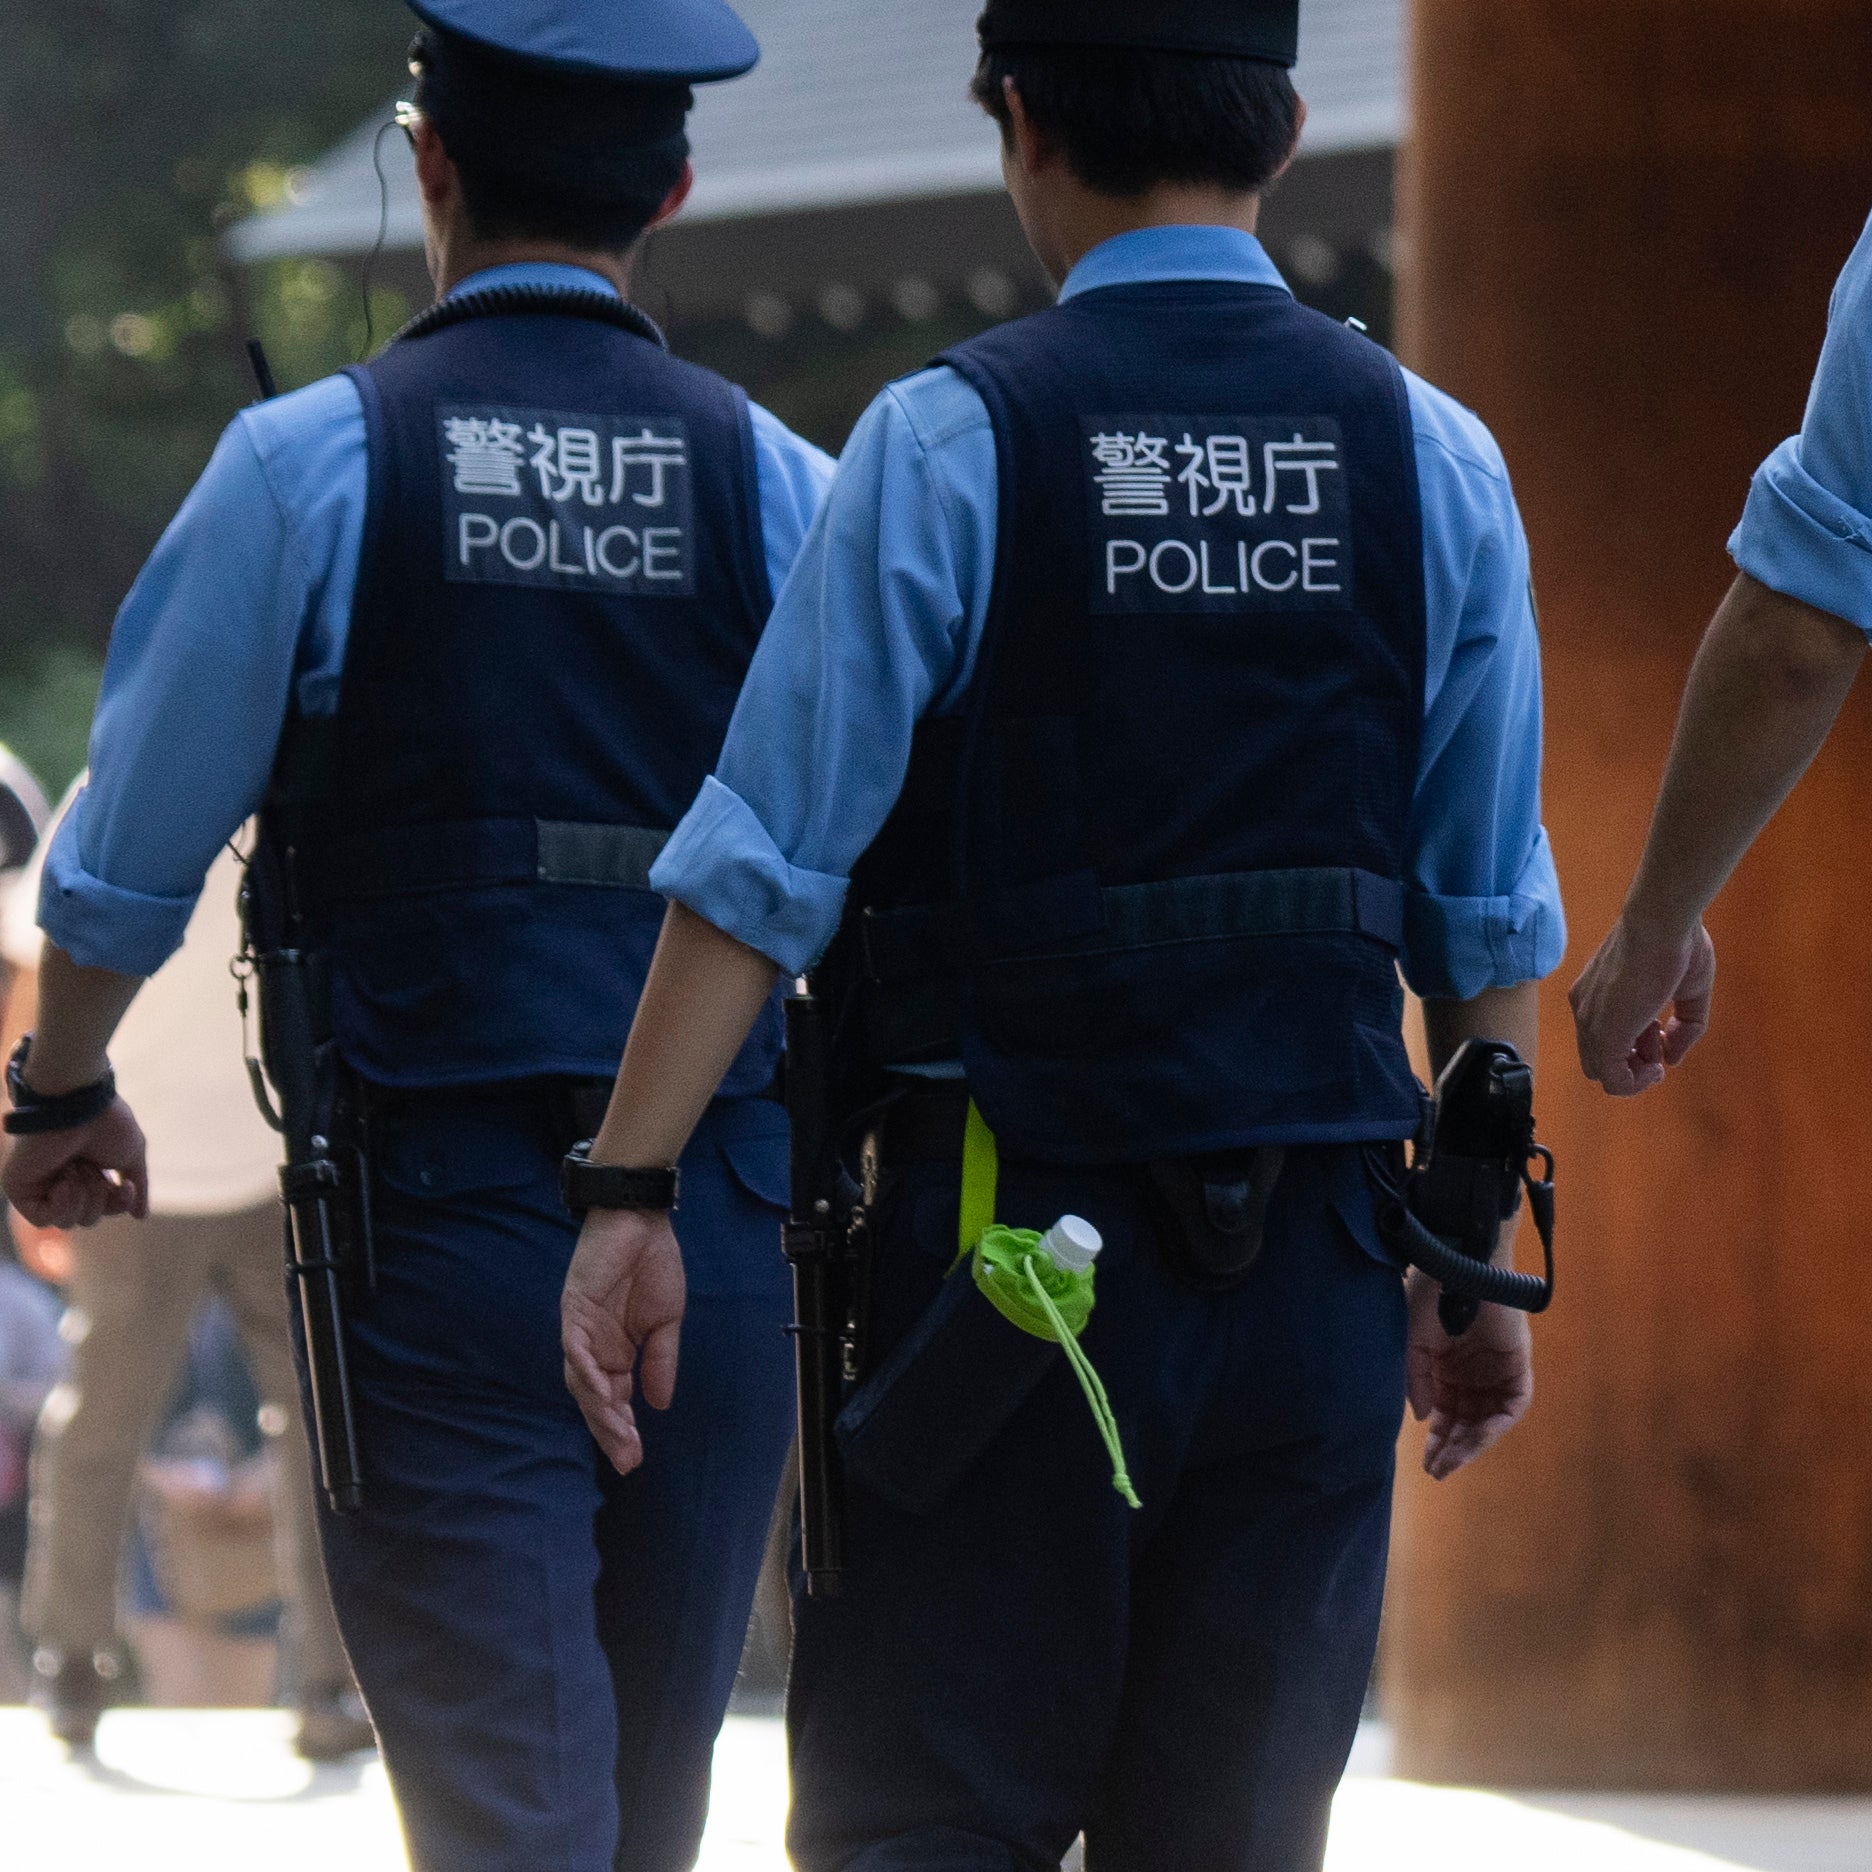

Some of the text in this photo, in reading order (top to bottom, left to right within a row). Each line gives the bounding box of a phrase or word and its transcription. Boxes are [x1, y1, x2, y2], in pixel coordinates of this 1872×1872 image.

[443, 417, 686, 507] 警視庁
[1090, 431, 1339, 517] 警視庁
[459, 513, 683, 579] POLICE
[1106, 537, 1342, 595] POLICE
